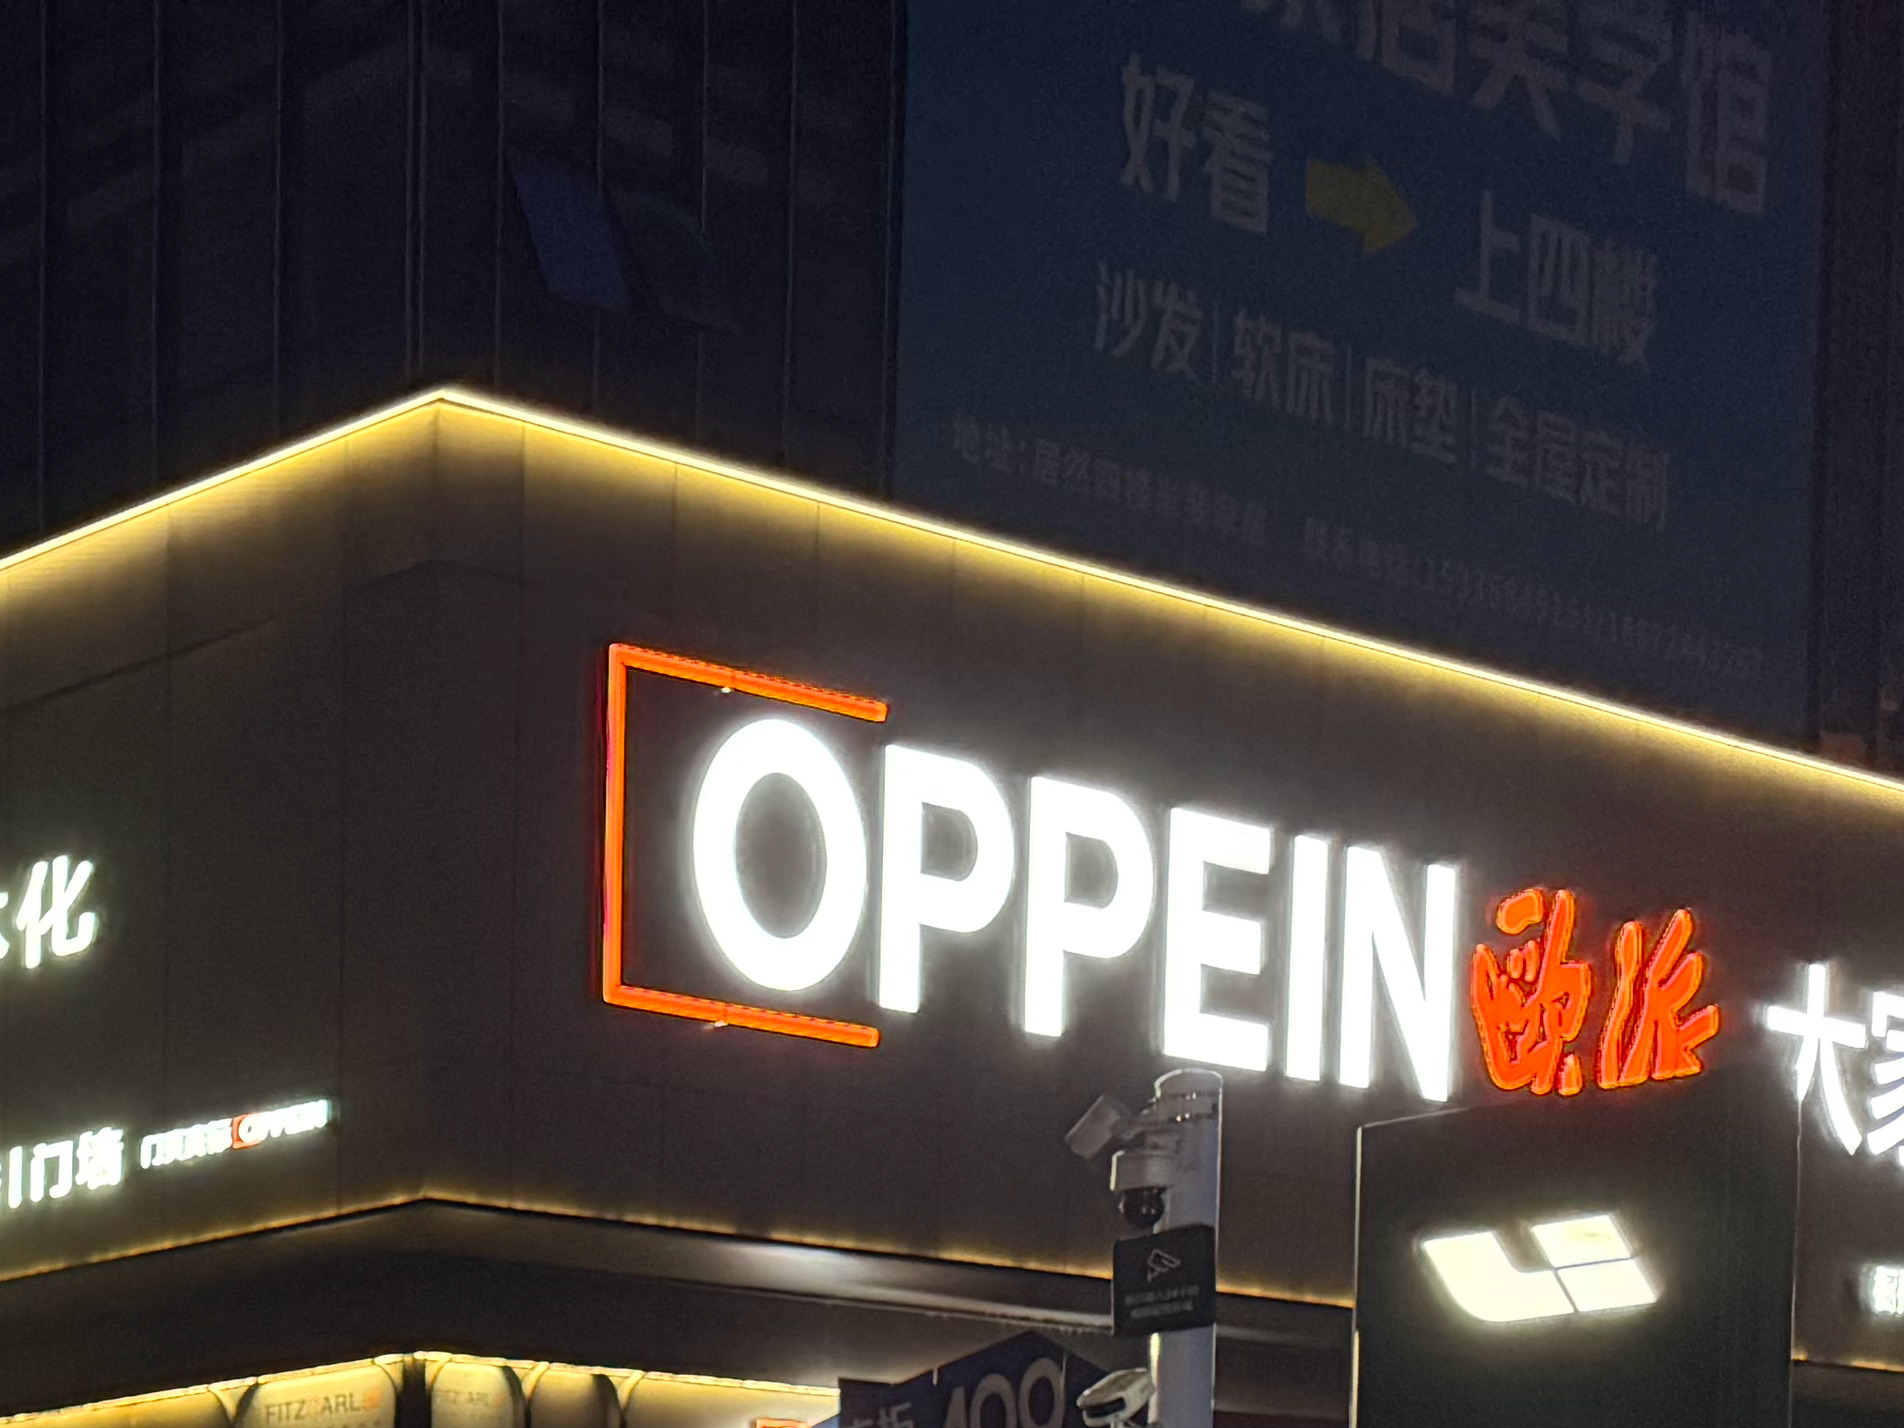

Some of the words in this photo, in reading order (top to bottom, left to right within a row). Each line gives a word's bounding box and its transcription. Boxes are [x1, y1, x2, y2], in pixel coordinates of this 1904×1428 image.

[1120, 52, 1273, 237] 好看
[1093, 263, 1205, 376] 沙发
[1484, 402, 1671, 532] 全屋定制
[693, 717, 1459, 1103] OPPEIN
